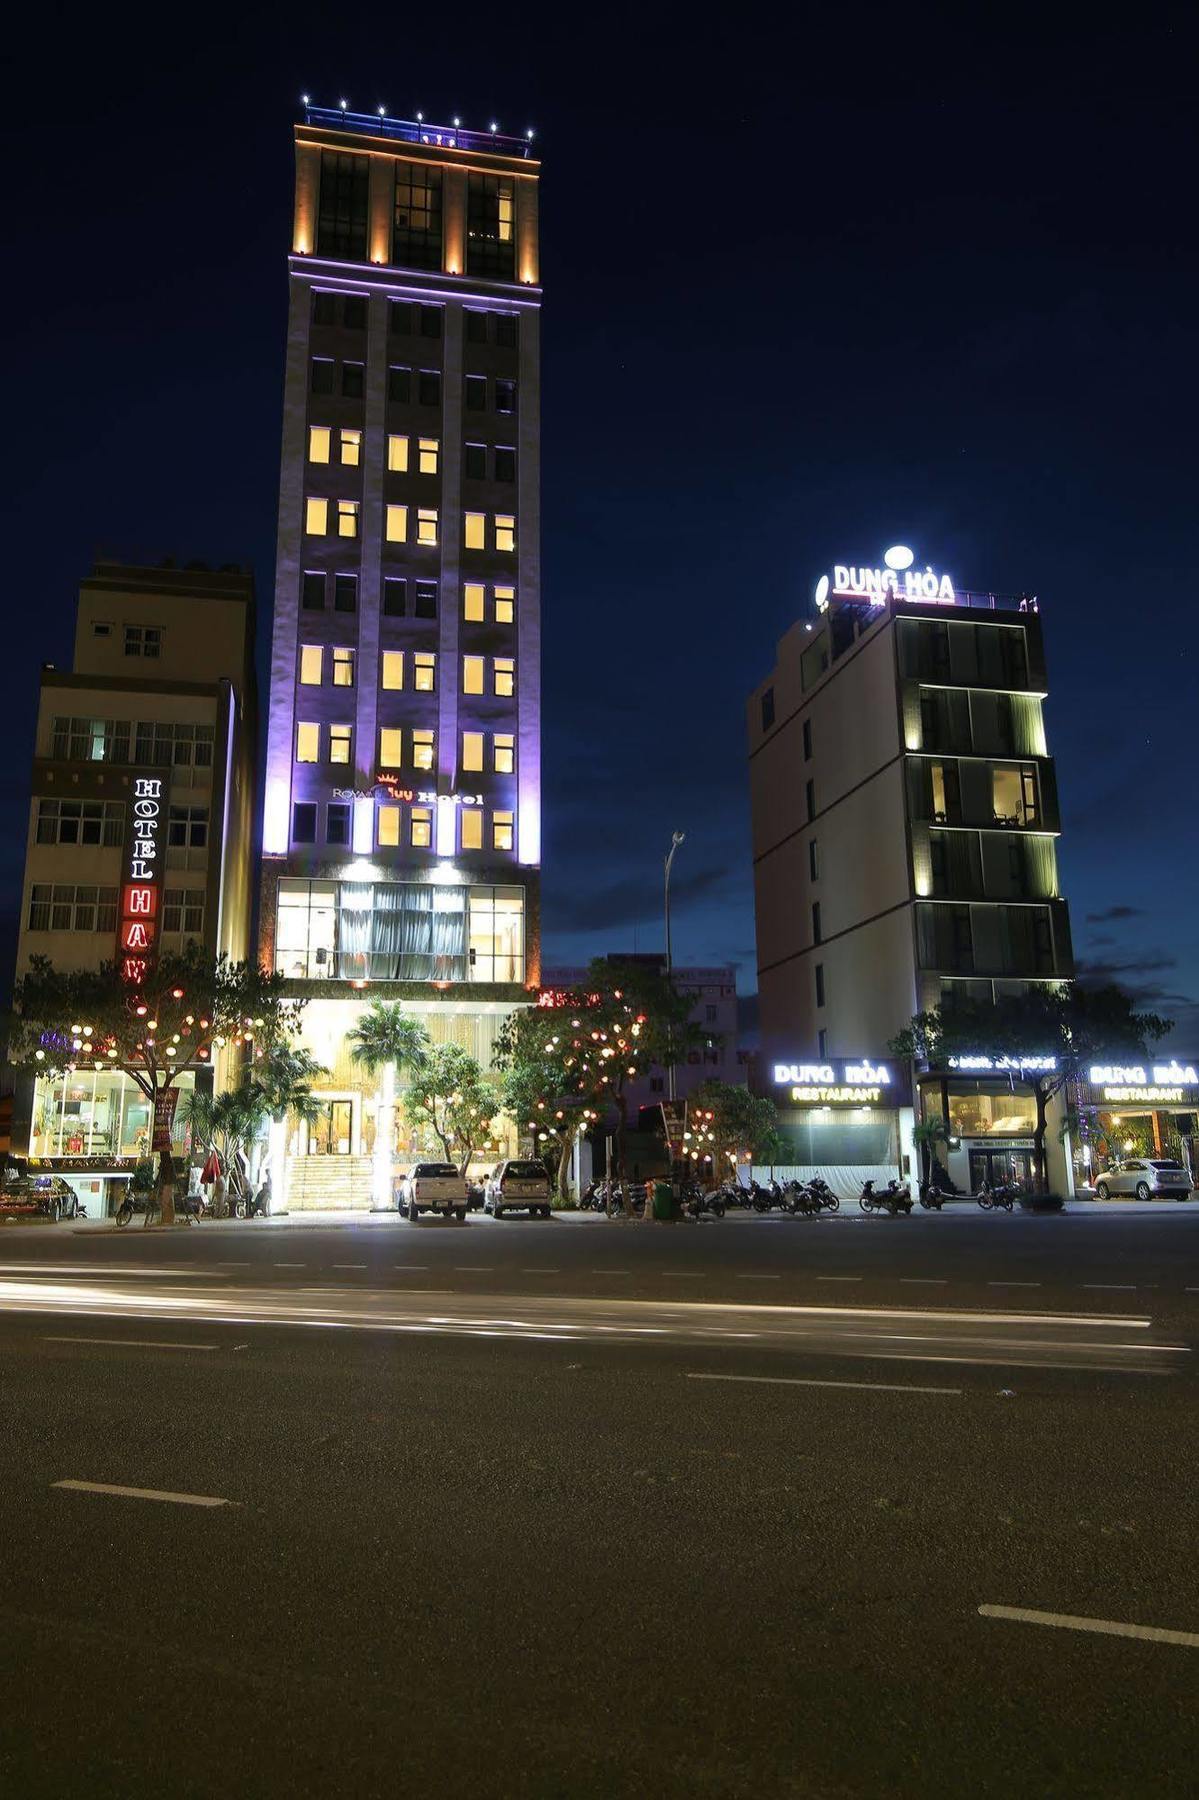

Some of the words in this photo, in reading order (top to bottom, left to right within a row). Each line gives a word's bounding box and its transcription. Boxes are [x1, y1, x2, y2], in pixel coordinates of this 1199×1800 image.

[834, 565, 898, 594] DUNG
[905, 566, 955, 598] HÒA
[417, 791, 484, 805] Hotel
[131, 779, 161, 879] HOTEL
[774, 1065, 834, 1083] DUNG
[845, 1059, 890, 1083] HÒA
[1090, 1066, 1146, 1083] DUNG
[1153, 1060, 1198, 1083] HÒA
[792, 1087, 880, 1101] RESTAURANT
[1104, 1087, 1183, 1101] RESTAURANT
